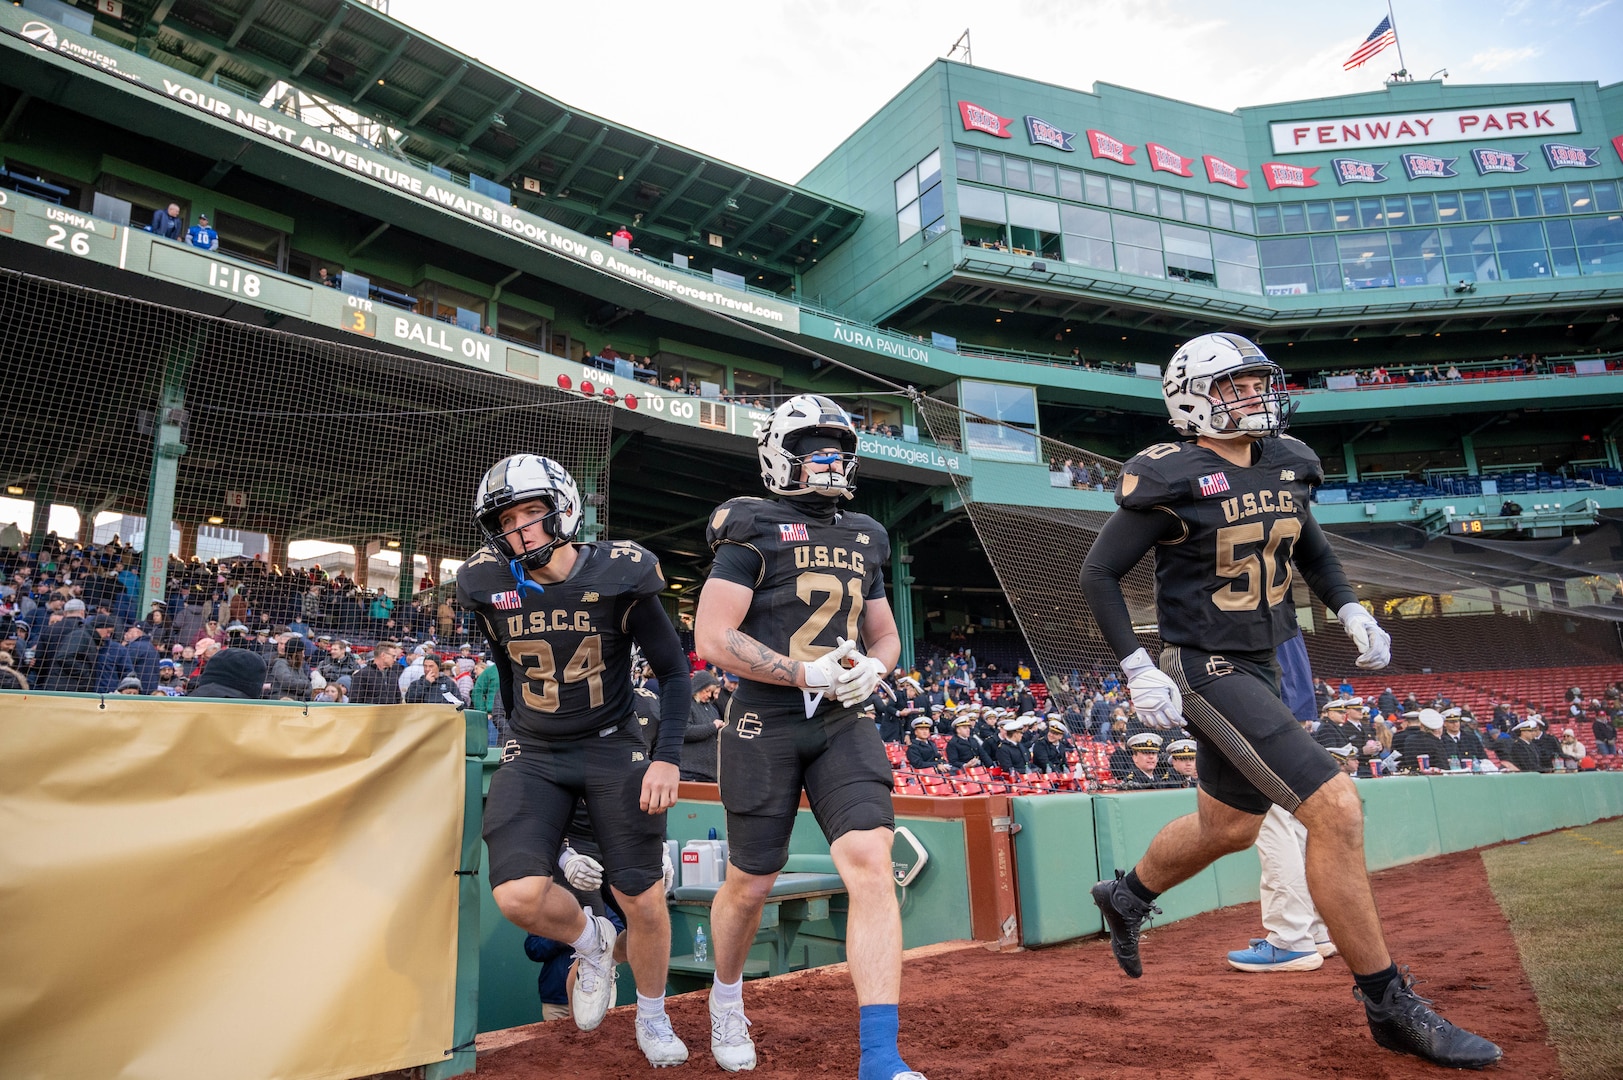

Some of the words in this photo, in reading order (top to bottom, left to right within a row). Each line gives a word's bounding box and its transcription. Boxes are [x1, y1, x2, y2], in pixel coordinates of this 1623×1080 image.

[60, 38, 118, 67] American
[1293, 118, 1434, 146] FENWAY
[1458, 109, 1555, 133] PARK
[163, 79, 231, 118] YOUR
[236, 109, 297, 142] NEXT
[300, 136, 422, 194] ADVENTURE
[425, 184, 498, 223] AWAITS!
[501, 213, 548, 243] BOOK
[550, 233, 588, 258] NOW
[590, 250, 604, 266] @
[606, 256, 783, 322] AmericanForcesTravel.com
[46, 207, 96, 232] USMMA
[45, 224, 90, 256] 26
[209, 262, 261, 298] 1:18
[347, 295, 373, 313] QTR
[352, 312, 366, 331] 3
[394, 316, 454, 353] BALL
[461, 337, 491, 363] ON
[876, 338, 929, 364] PAVILION
[583, 366, 614, 386] DOWN
[644, 391, 665, 412] TO
[669, 399, 694, 419] GO
[857, 436, 929, 465] Technologies
[1221, 490, 1298, 524] U.S.C.G.
[793, 546, 867, 577] U.S.C.G.
[1211, 517, 1302, 612] 50
[507, 610, 597, 637] U.S.C.G.
[789, 571, 863, 668] 21
[506, 633, 607, 713] 34
